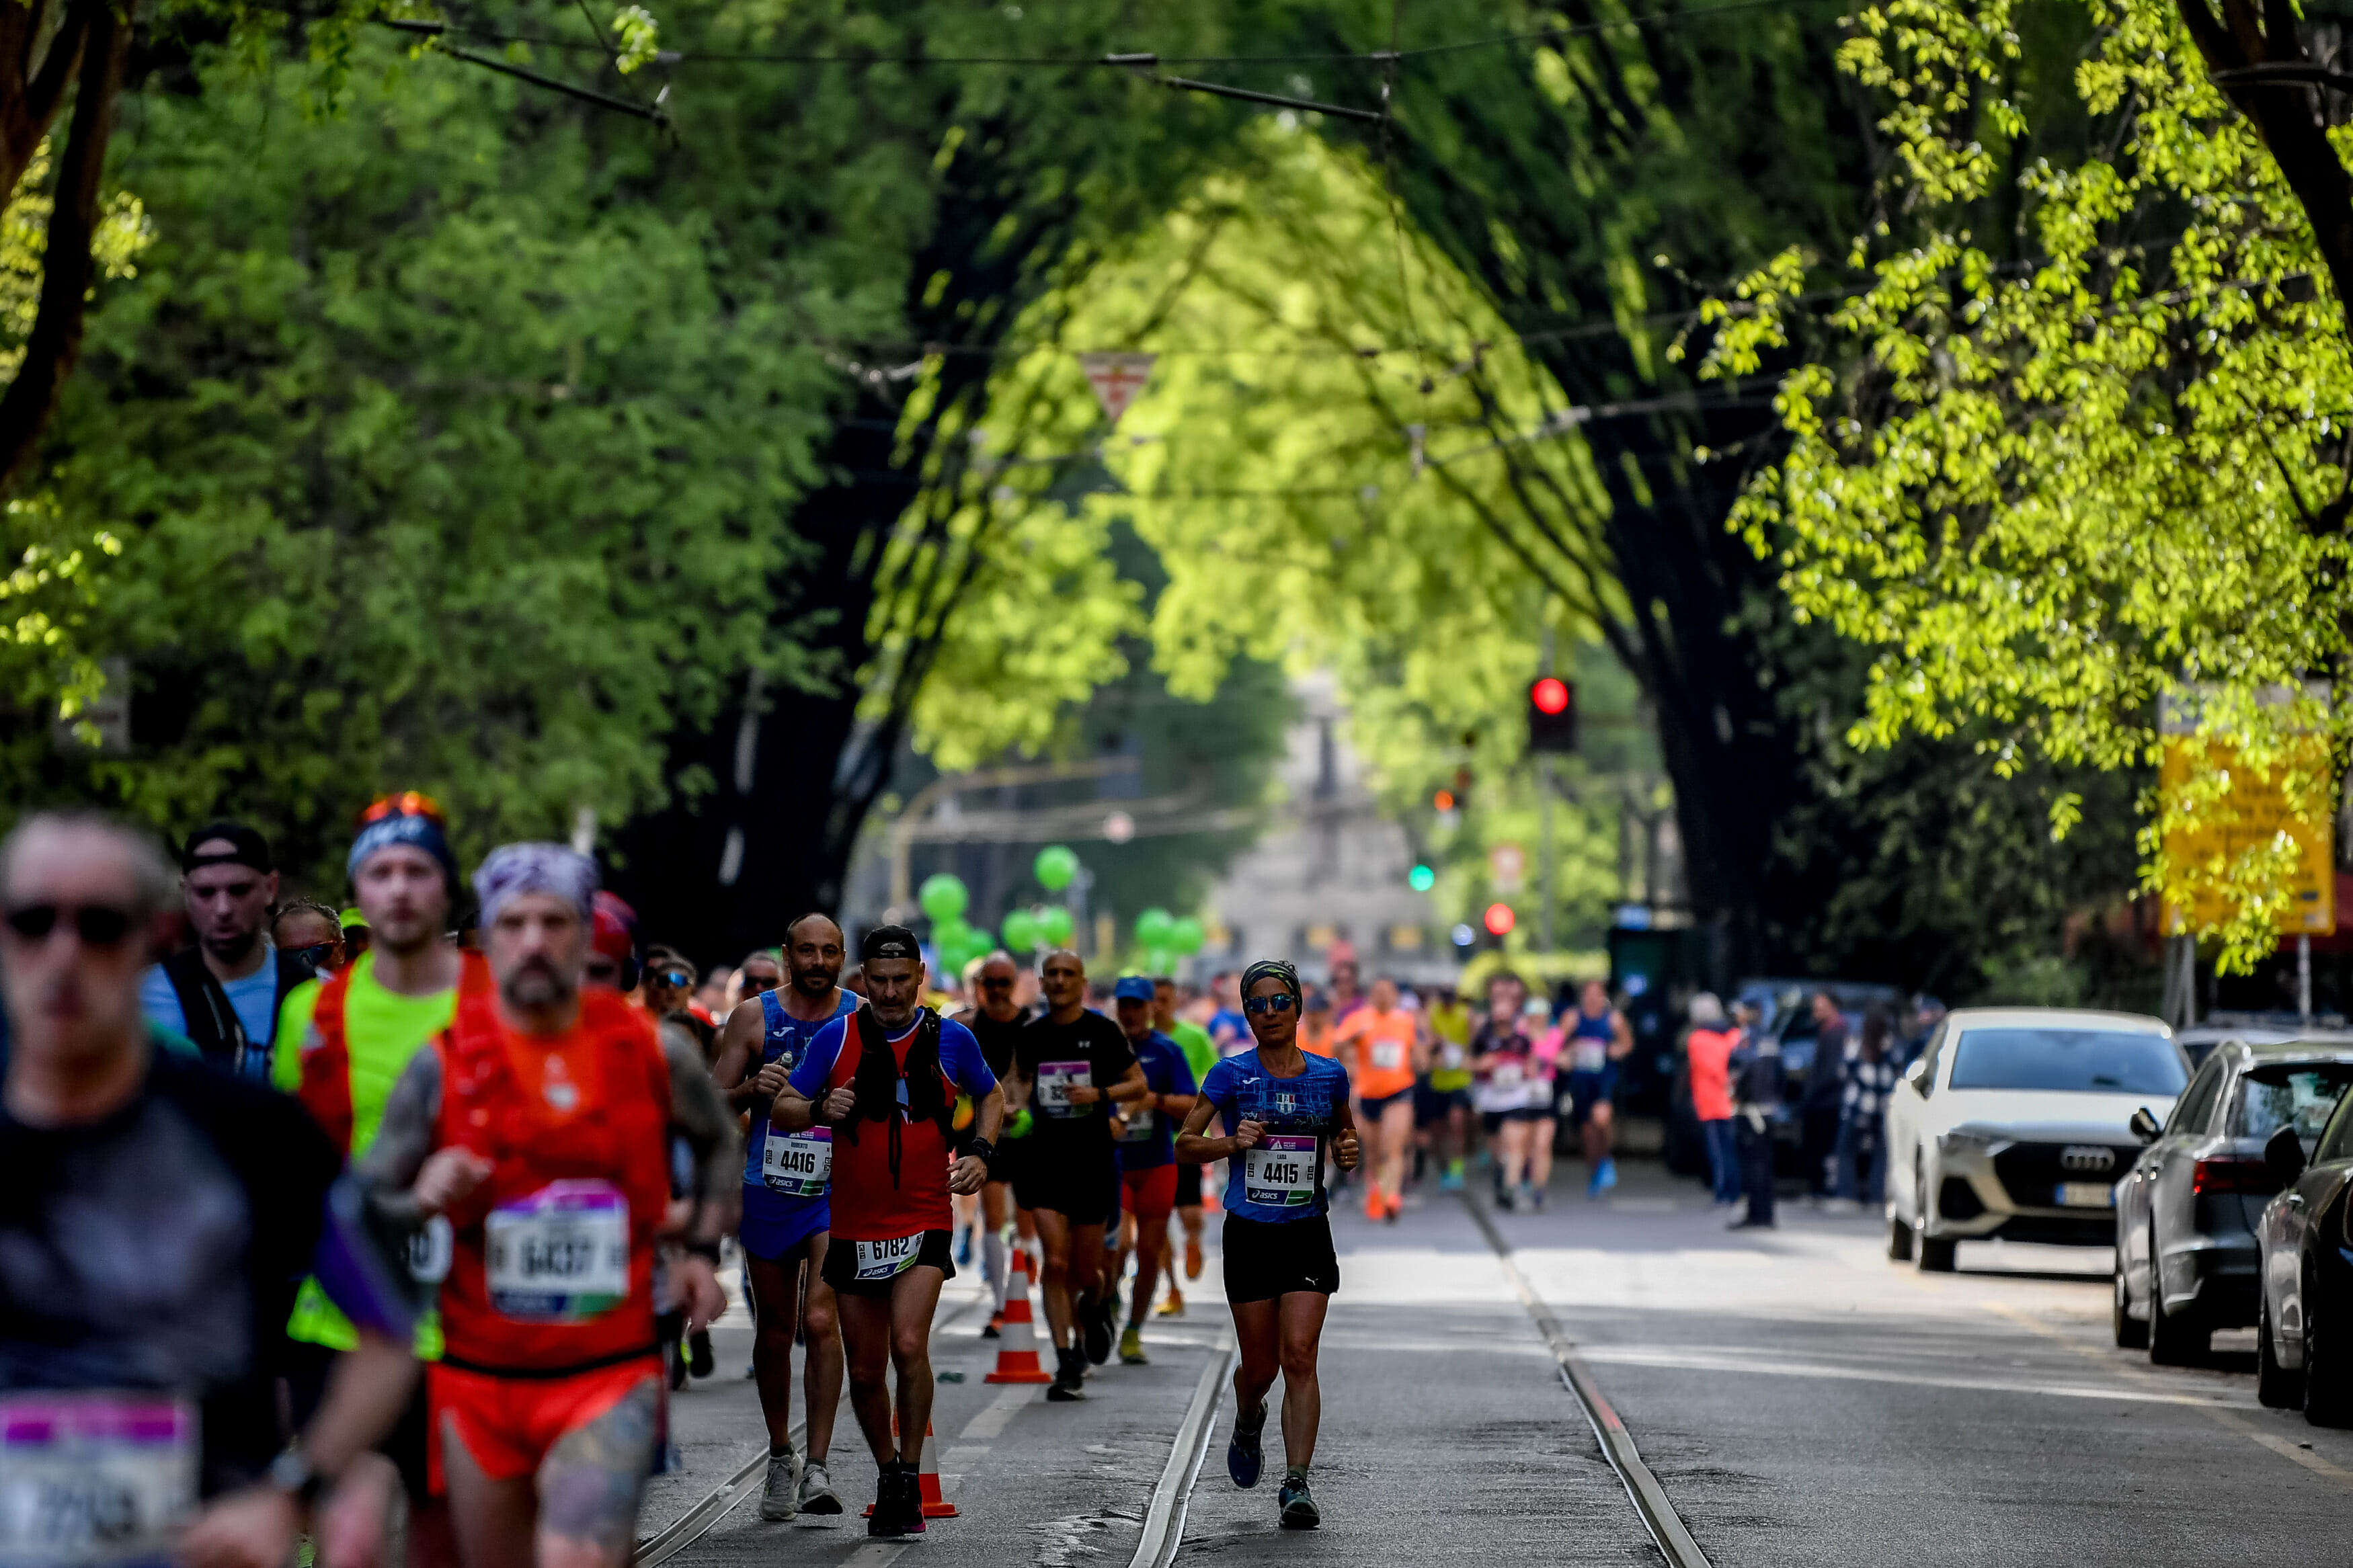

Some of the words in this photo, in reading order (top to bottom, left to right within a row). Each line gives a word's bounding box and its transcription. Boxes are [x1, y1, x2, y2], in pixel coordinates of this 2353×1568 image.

[781, 1150, 815, 1174] 4416
[1263, 1163, 1299, 1184] 4415
[775, 1178, 793, 1187] asics
[1259, 1192, 1278, 1200] asics
[873, 1236, 910, 1260] 6782
[871, 1266, 889, 1276] asics
